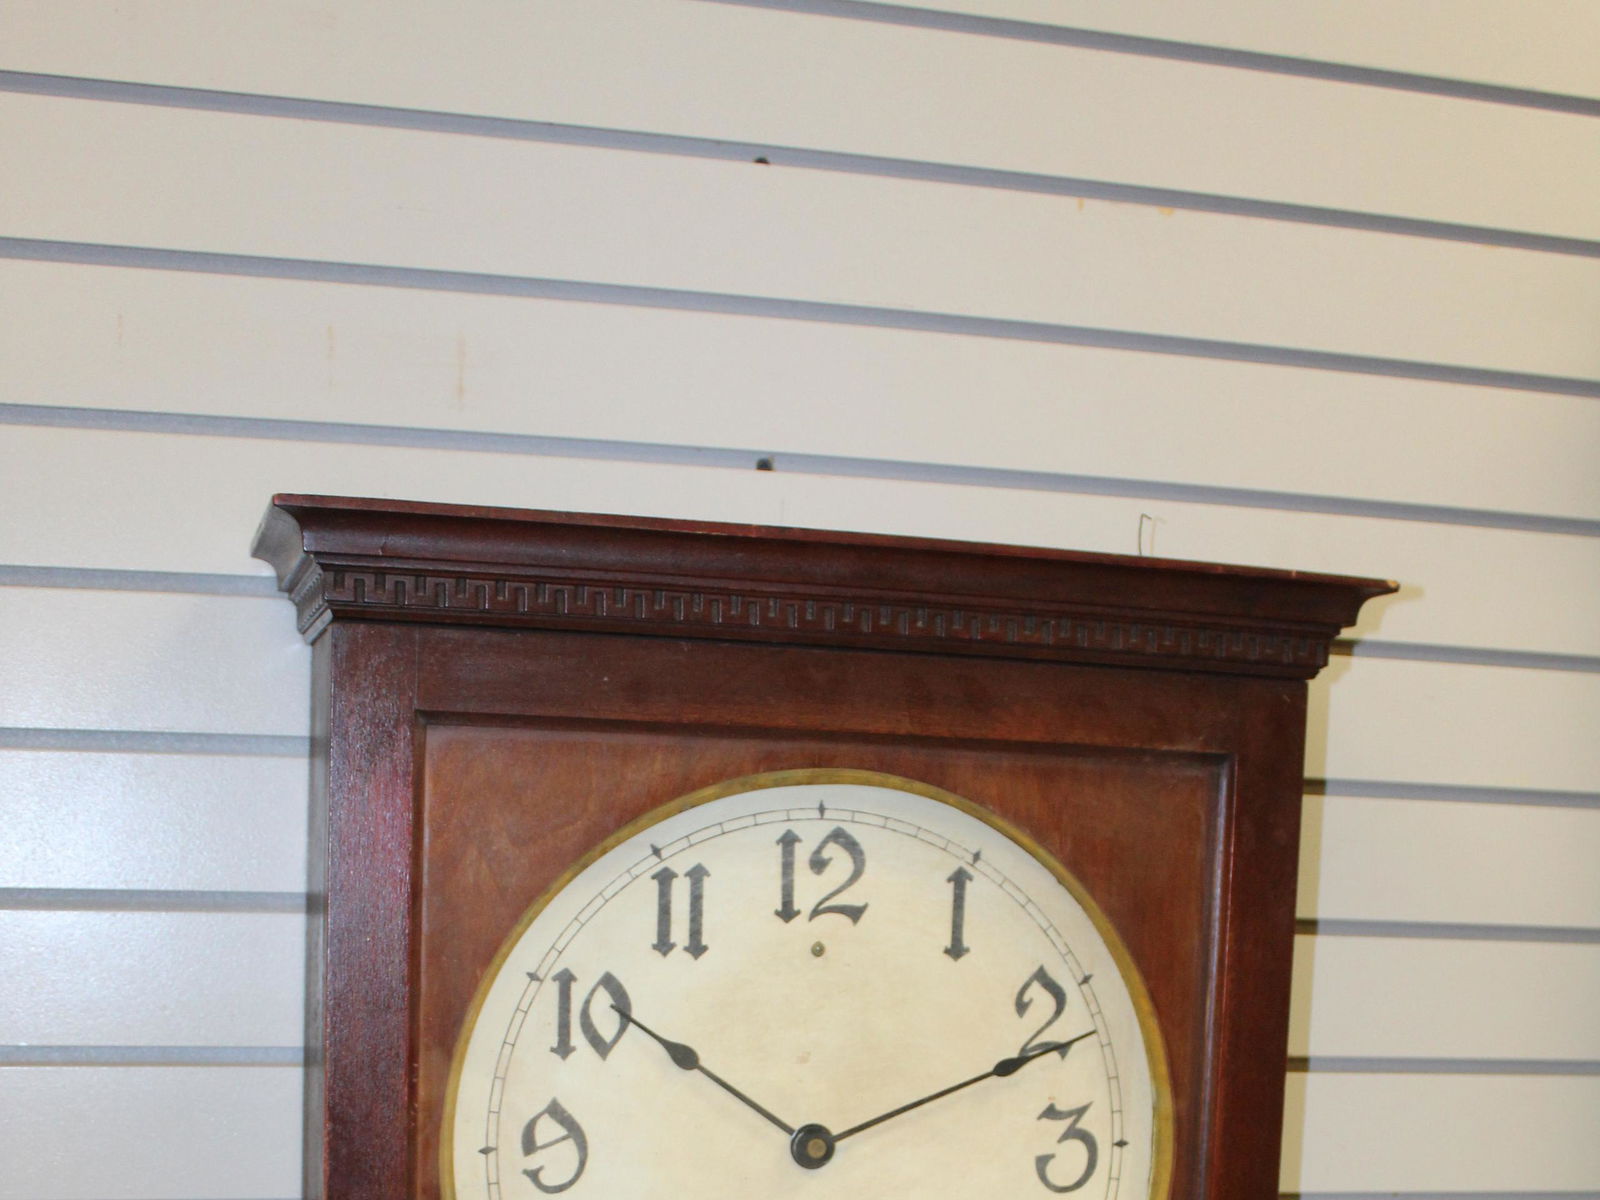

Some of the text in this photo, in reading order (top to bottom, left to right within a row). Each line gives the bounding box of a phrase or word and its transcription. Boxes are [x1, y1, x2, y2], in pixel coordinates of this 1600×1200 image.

[651, 862, 712, 961] 11
[775, 826, 869, 926] 12
[942, 865, 974, 962] 1
[549, 967, 633, 1061] 10
[1014, 965, 1074, 1060] 2
[520, 1097, 589, 1194] 9
[1035, 1100, 1099, 1193] 3
